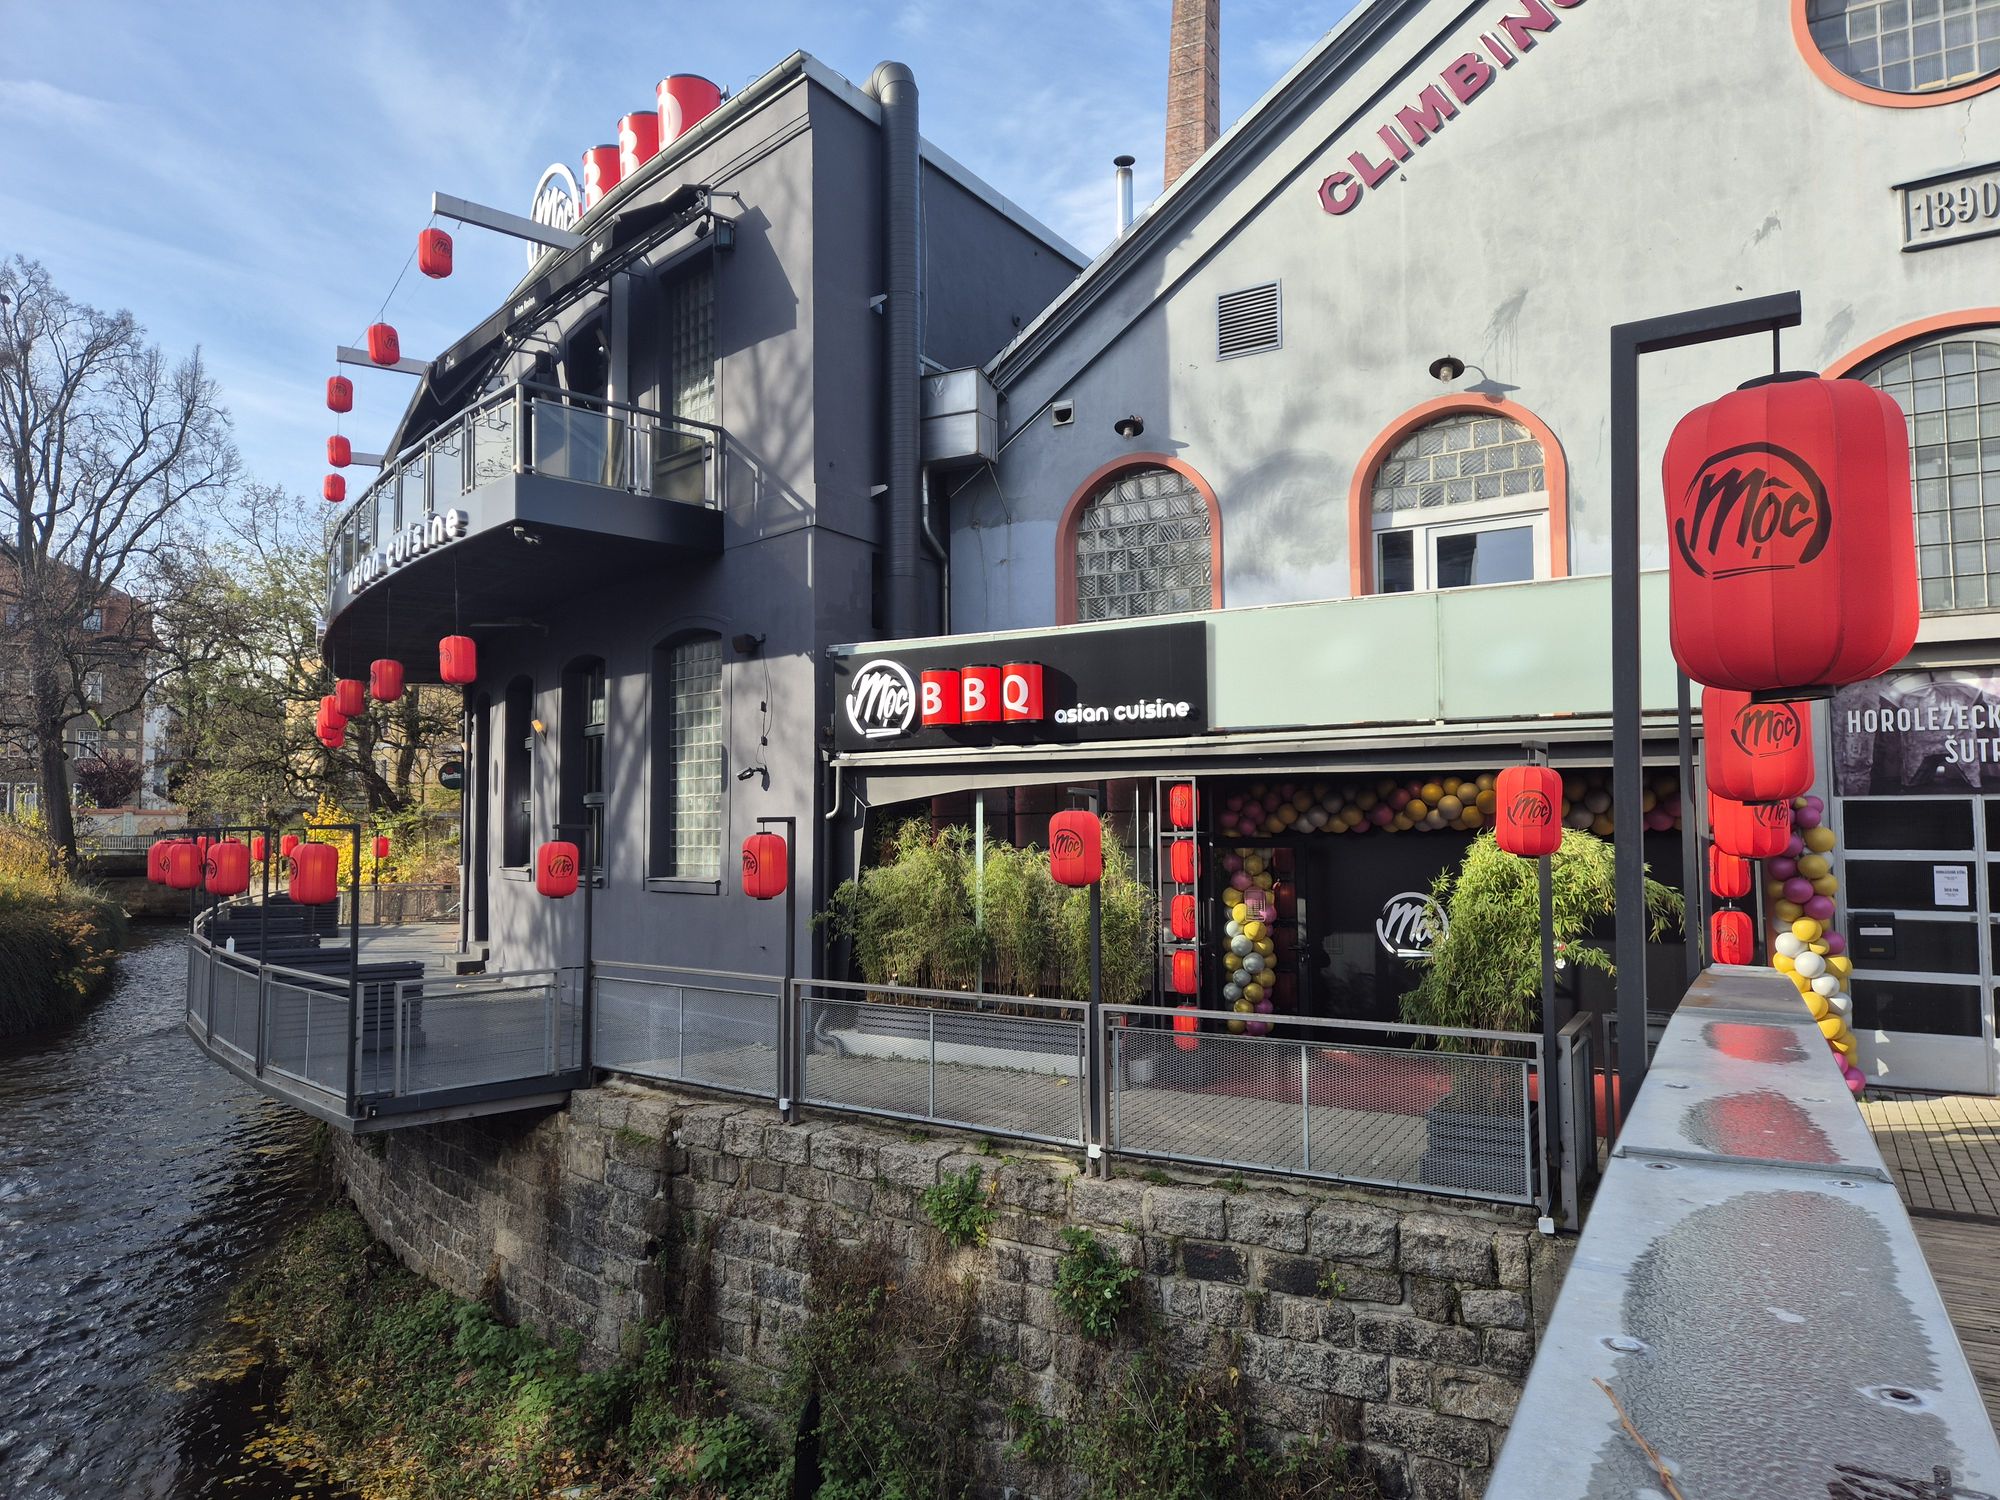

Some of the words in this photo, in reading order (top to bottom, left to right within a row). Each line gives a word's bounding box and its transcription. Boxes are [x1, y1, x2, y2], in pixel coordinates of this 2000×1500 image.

[1317, 0, 1587, 215] CLIMBIN
[1914, 181, 2000, 232] 1890
[386, 508, 466, 567] cuisine
[1054, 702, 1109, 724] asian
[1113, 698, 1190, 721] cuisine
